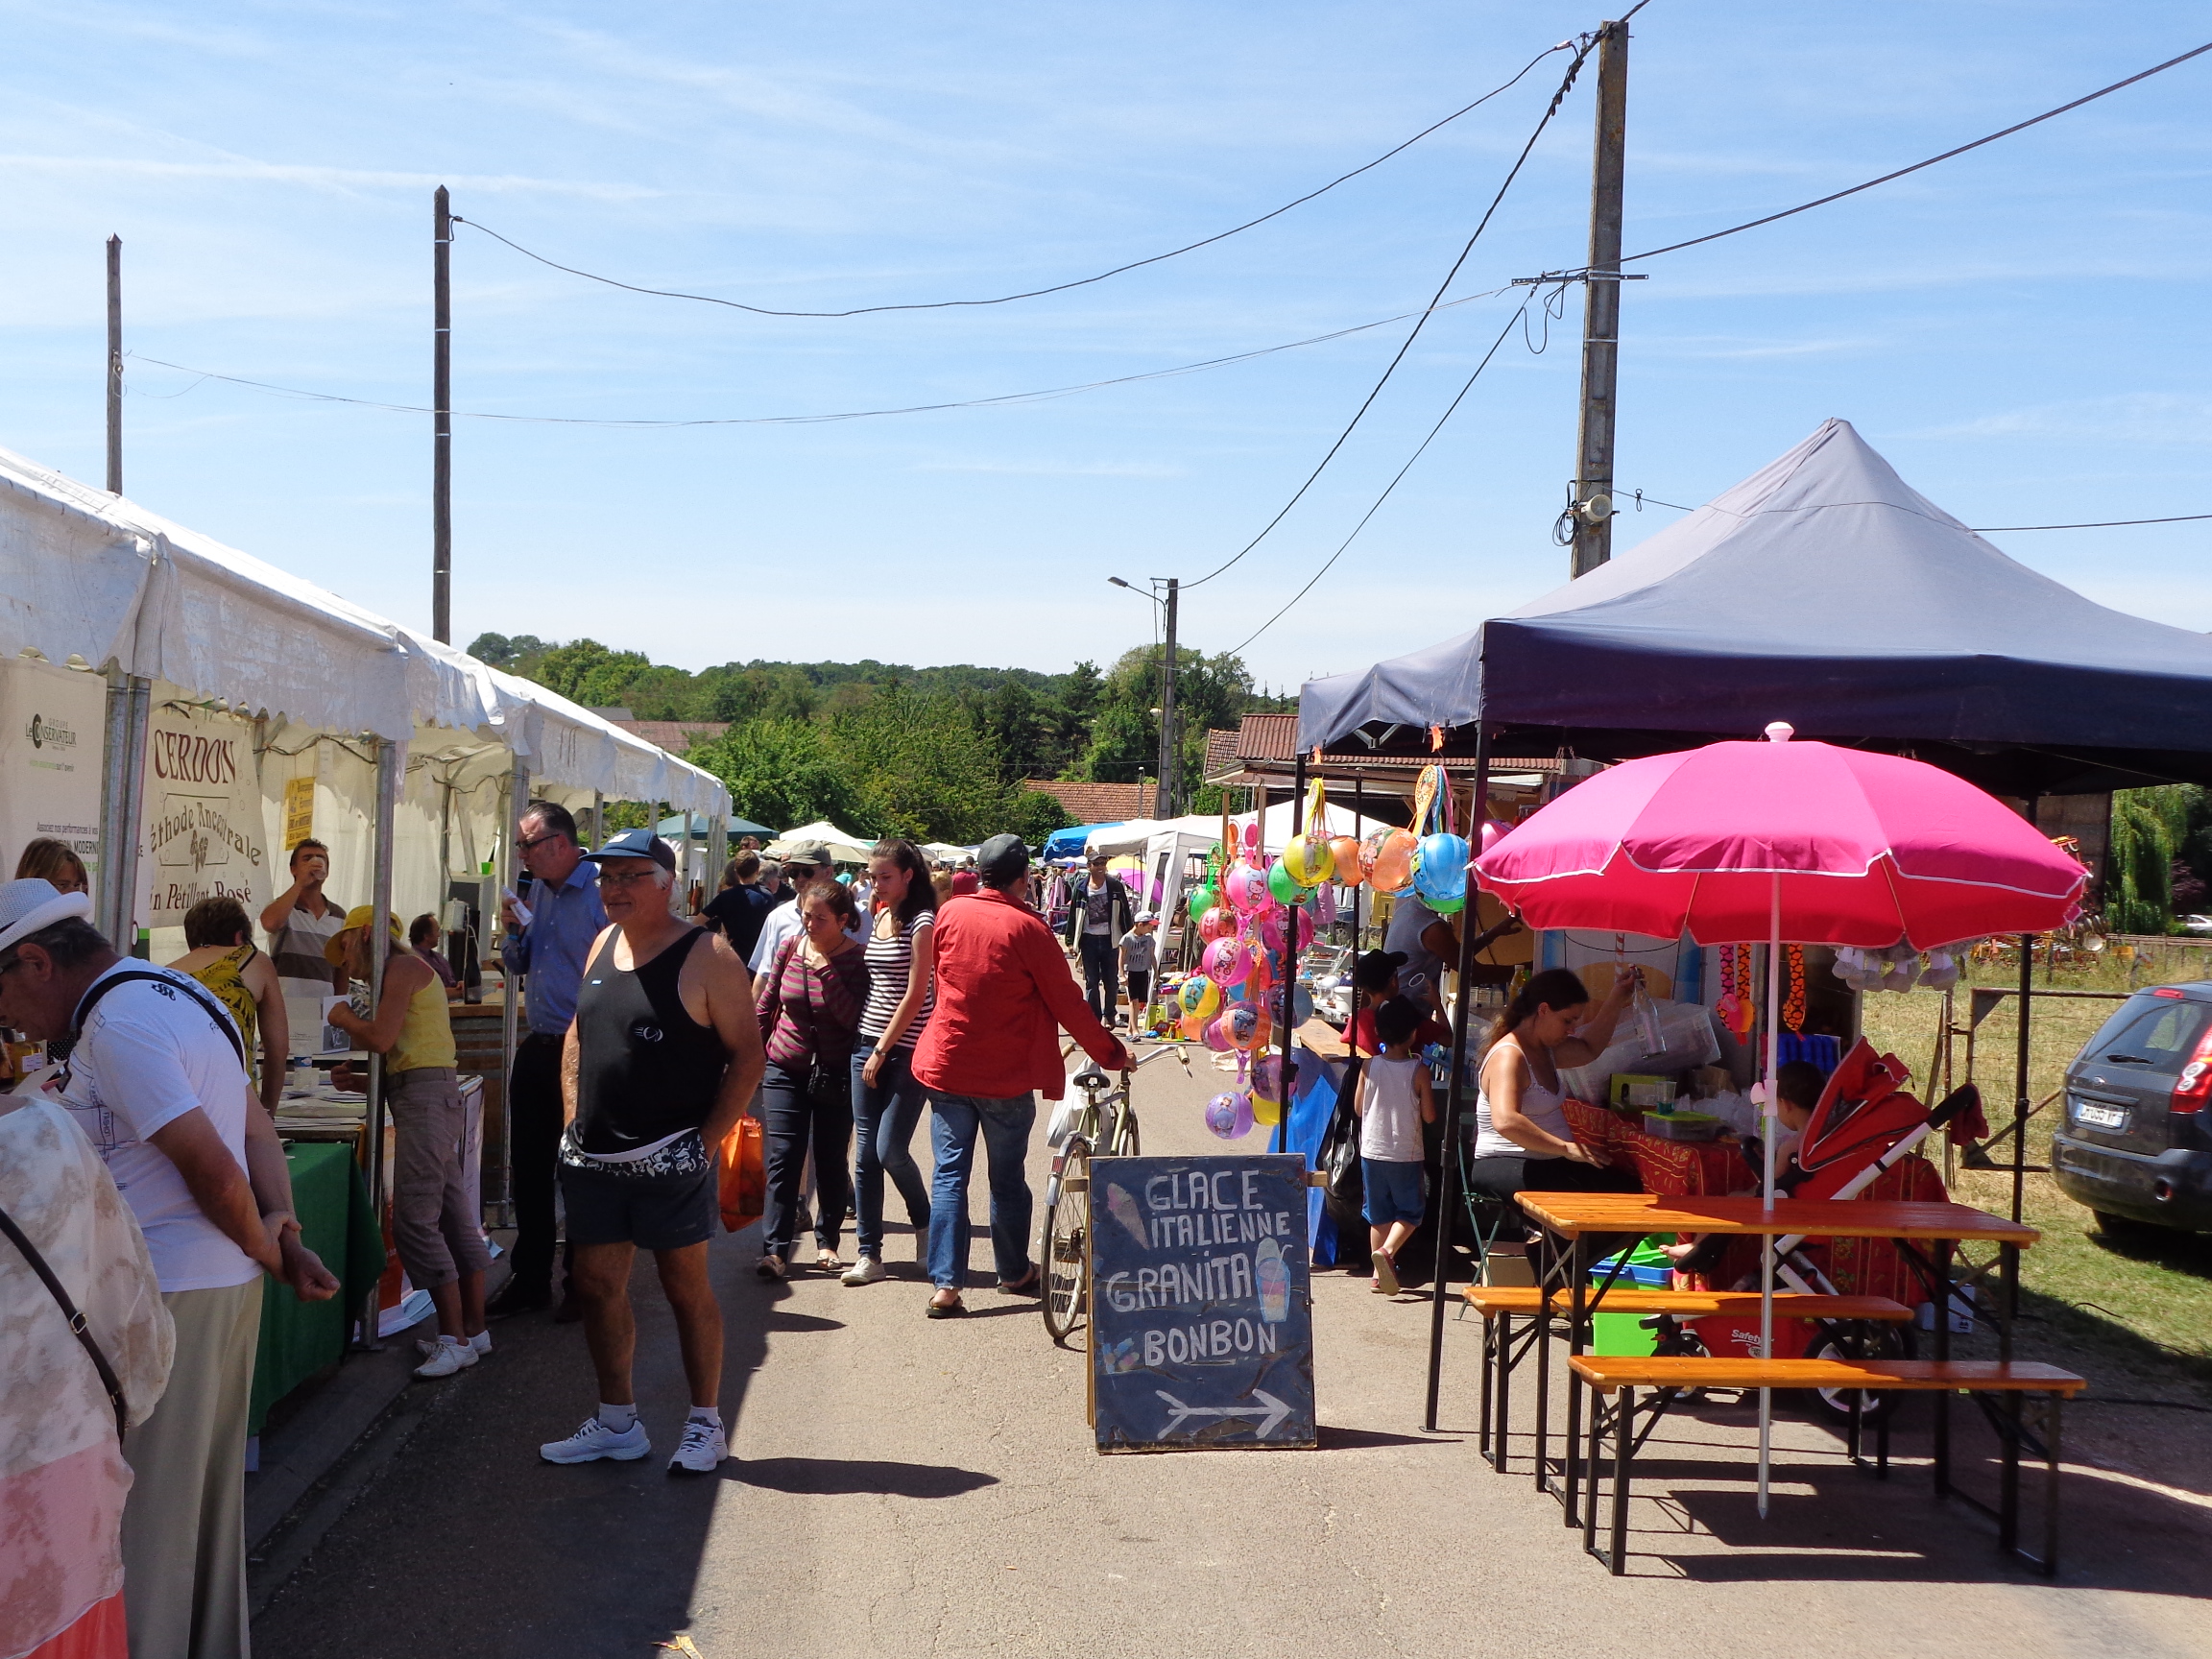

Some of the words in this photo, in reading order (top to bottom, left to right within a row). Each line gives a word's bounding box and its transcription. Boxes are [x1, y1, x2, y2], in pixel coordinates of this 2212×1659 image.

[26, 723, 33, 738] Le
[49, 717, 69, 731] GROUPE
[154, 728, 237, 784] CERDON
[150, 805, 194, 853] éthode
[196, 802, 262, 866] Ancestrale
[149, 884, 161, 910] in
[166, 881, 209, 910] Pétillant
[214, 878, 252, 904] Rosé
[1145, 1169, 1263, 1211] GLACE
[1144, 1318, 1277, 1366] BONBON
